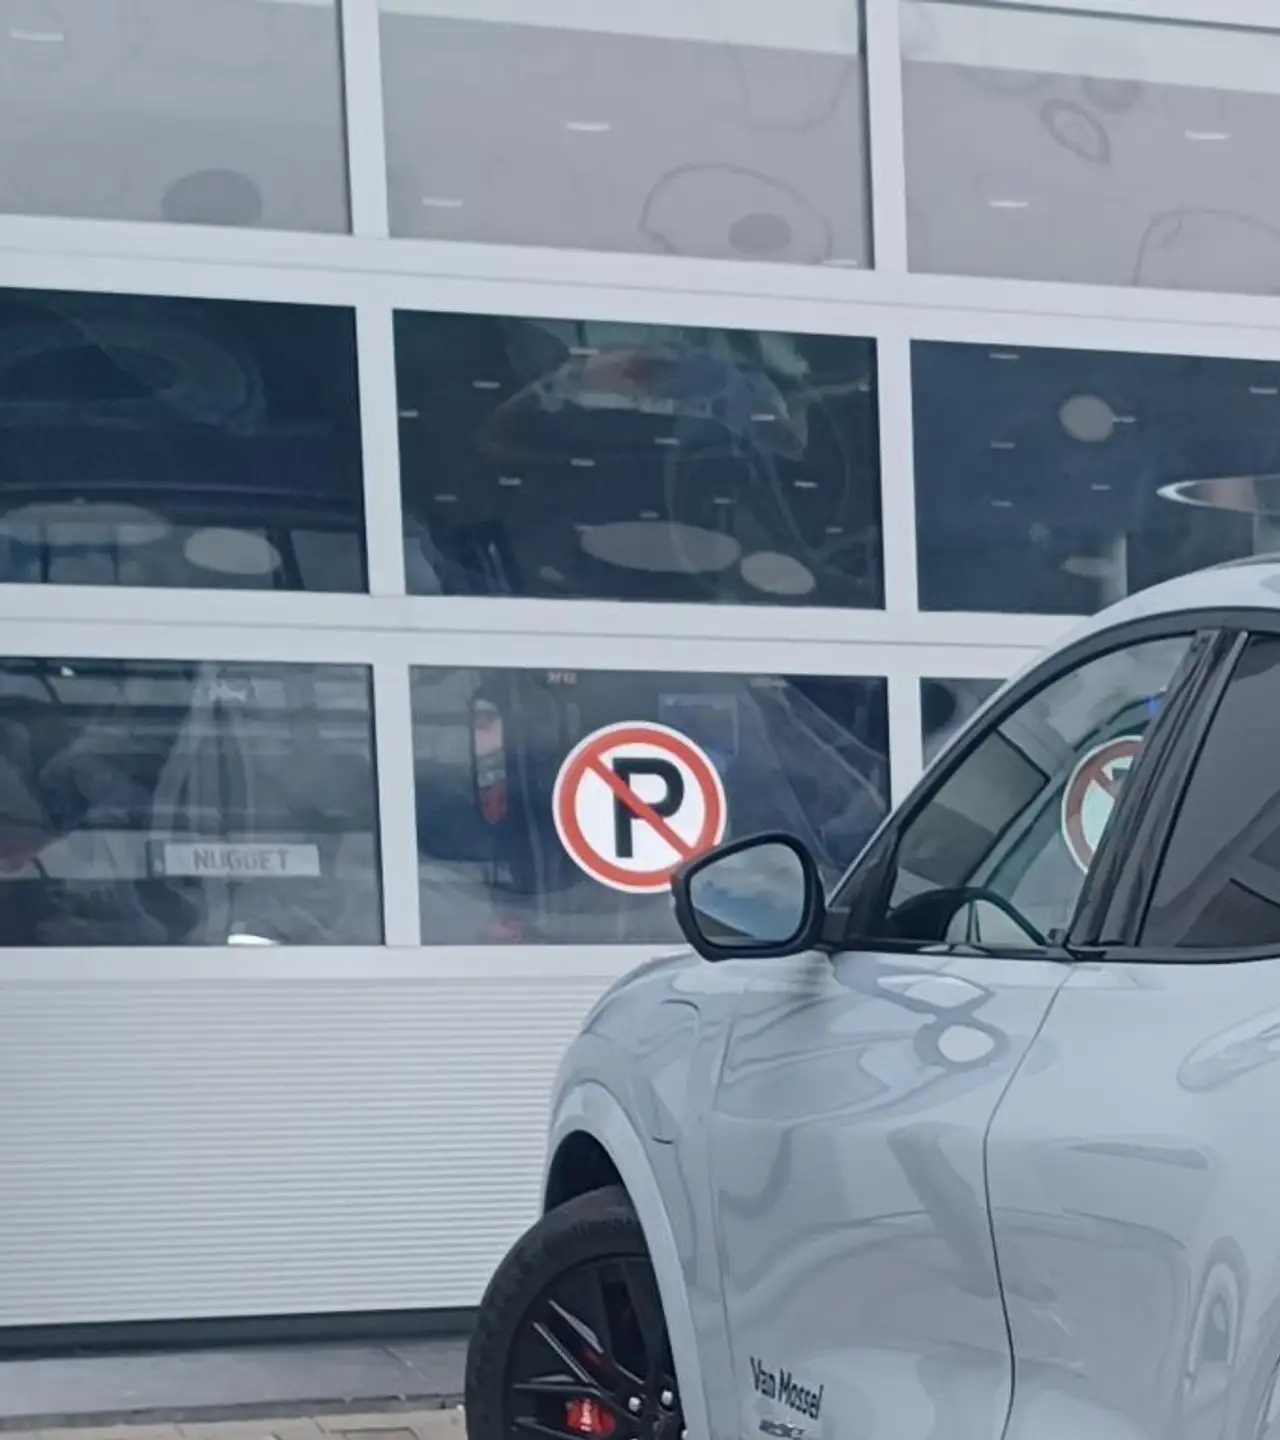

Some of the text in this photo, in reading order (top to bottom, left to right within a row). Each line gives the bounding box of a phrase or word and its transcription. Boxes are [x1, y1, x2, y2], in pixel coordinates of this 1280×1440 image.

[612, 757, 685, 859] P
[749, 1355, 825, 1421] Van Mossel
